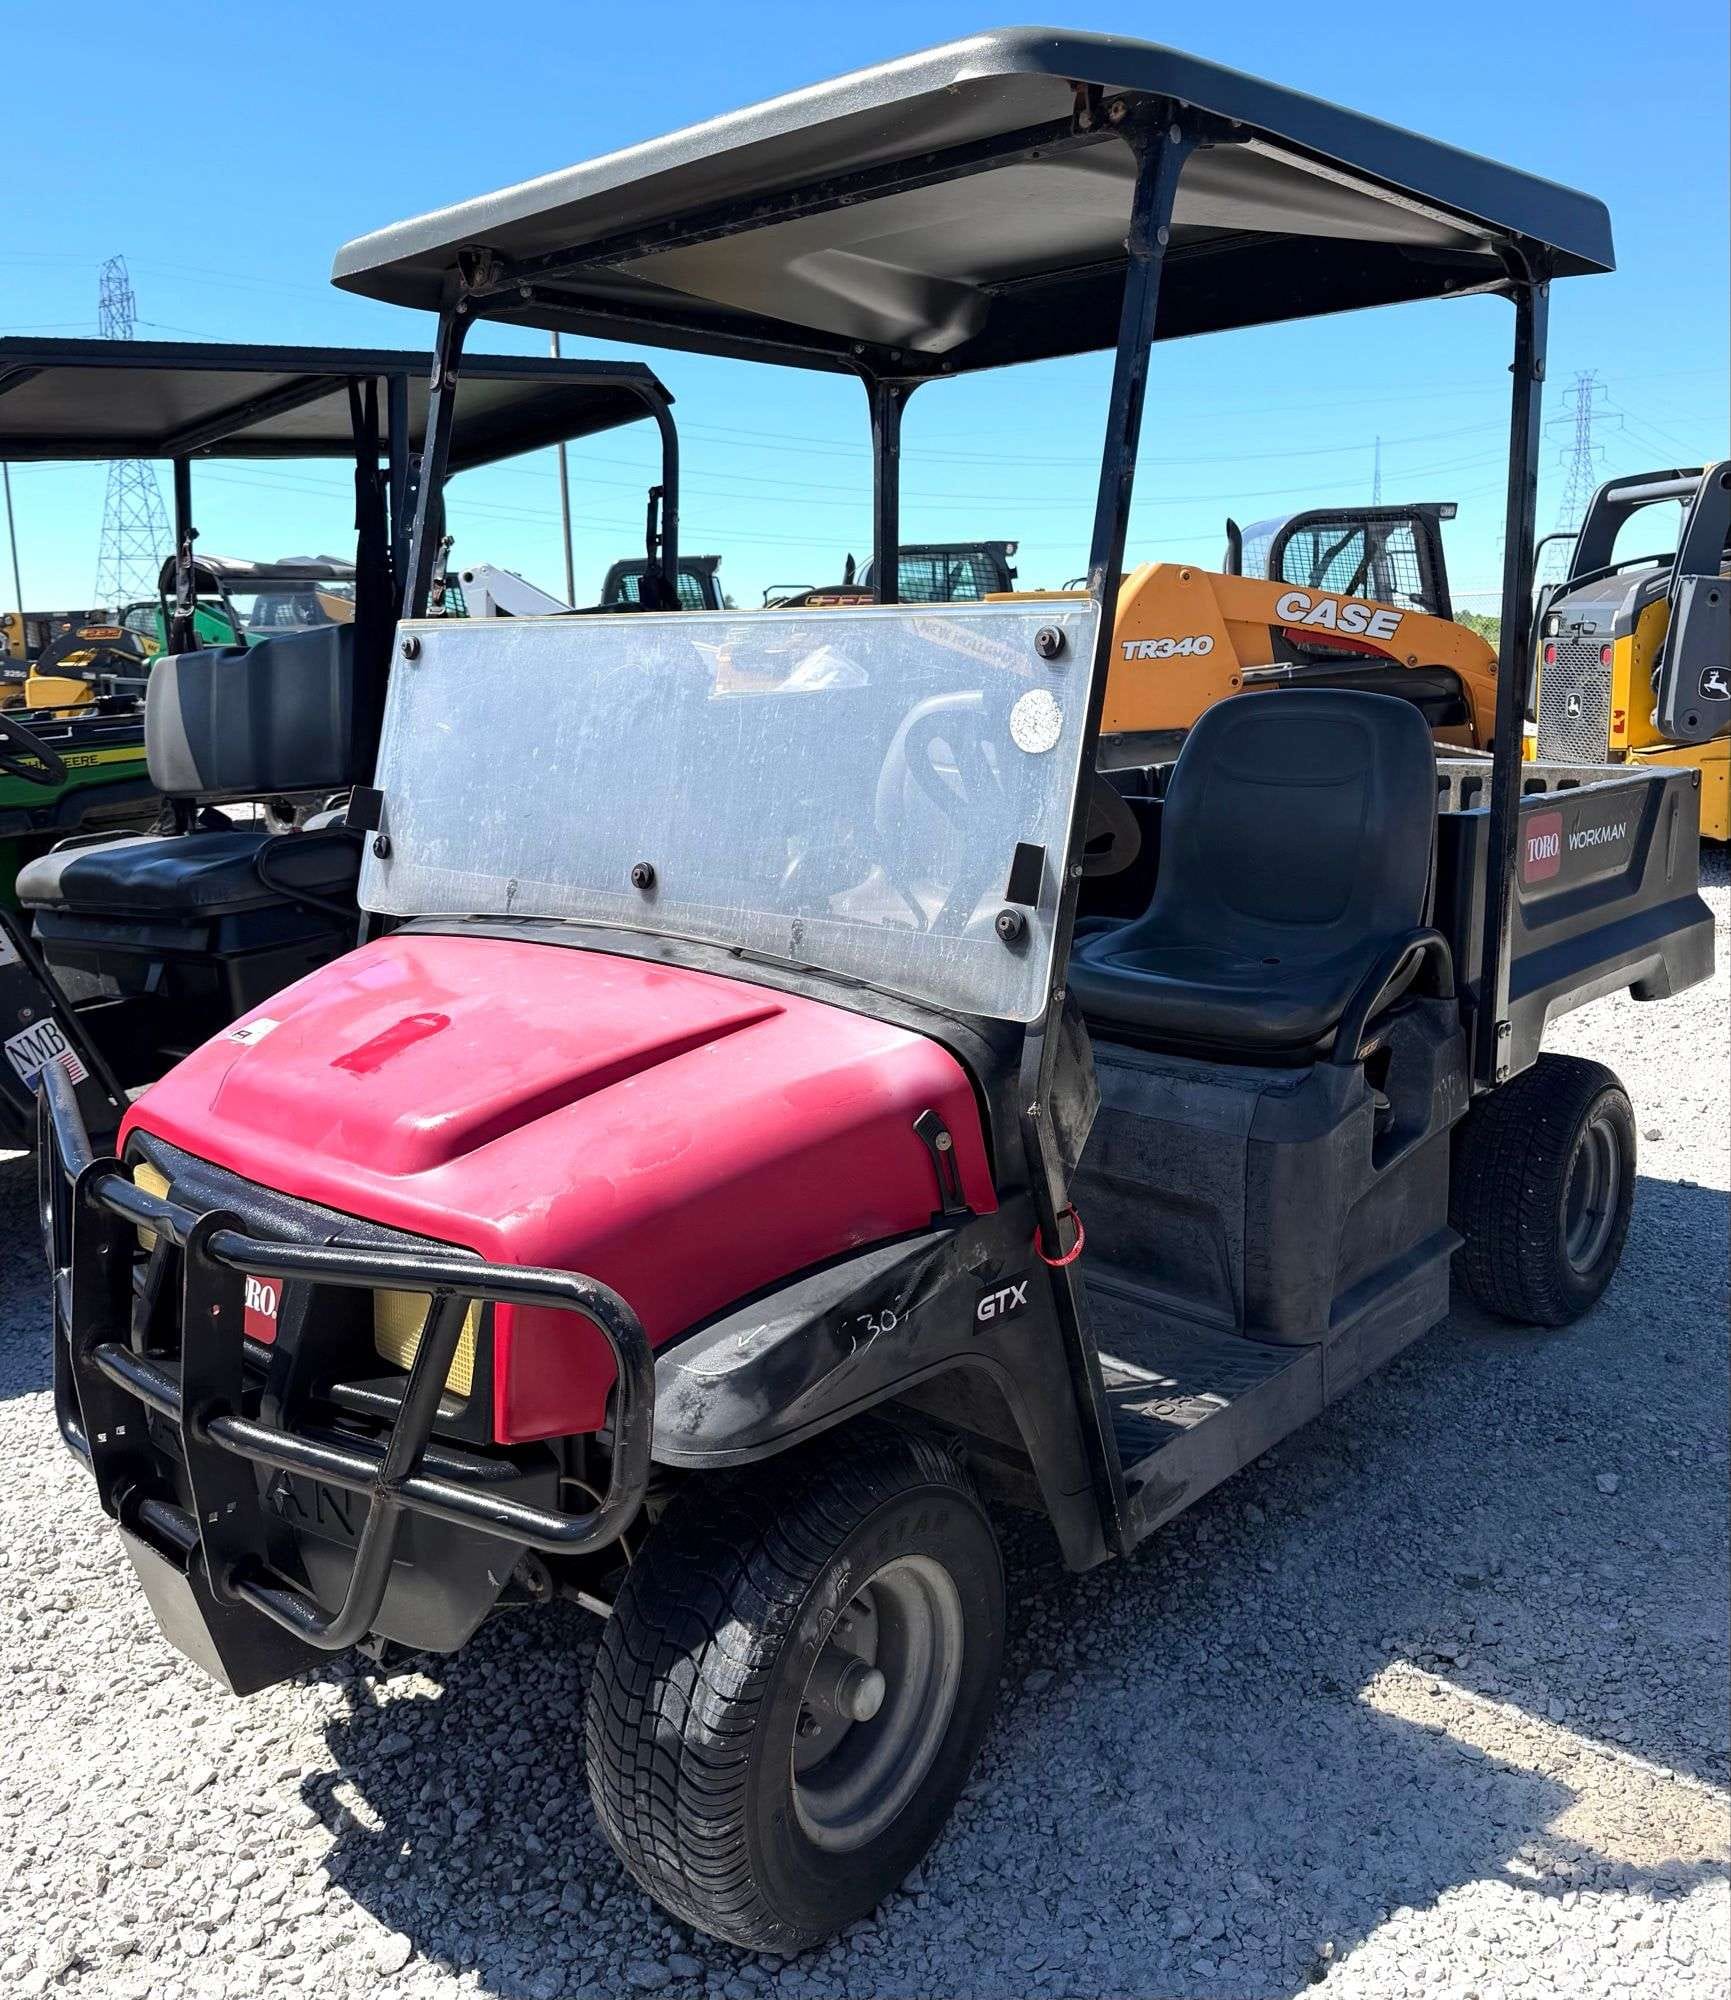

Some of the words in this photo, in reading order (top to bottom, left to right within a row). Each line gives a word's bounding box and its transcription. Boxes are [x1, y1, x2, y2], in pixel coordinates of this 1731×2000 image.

[1275, 591, 1403, 640] CASE
[1121, 634, 1215, 661] TR340
[64, 755, 99, 767] EERE
[1528, 833, 1560, 862] TORO
[1569, 822, 1627, 850] WORKMAN
[7, 1022, 66, 1075] NMB
[977, 1281, 1028, 1321] GTX
